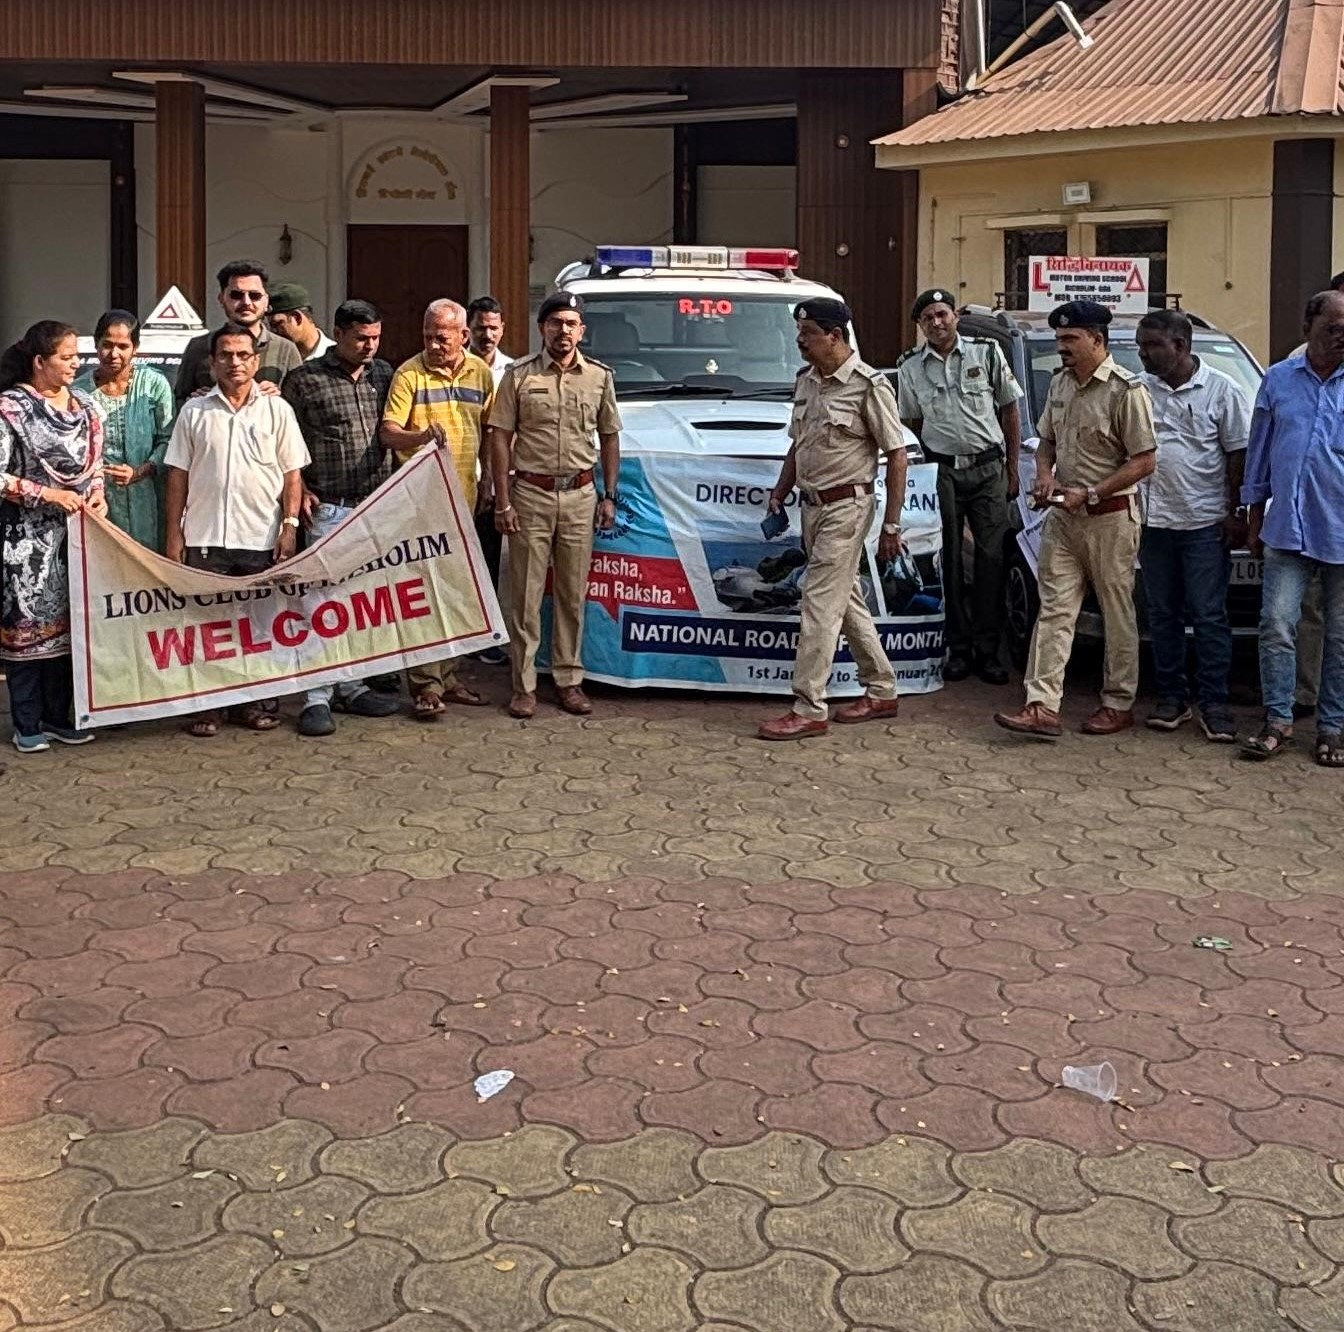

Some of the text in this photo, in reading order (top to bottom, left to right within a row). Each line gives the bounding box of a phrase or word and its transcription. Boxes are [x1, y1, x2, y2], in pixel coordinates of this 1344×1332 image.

[146, 578, 432, 670] WELCOME
[630, 622, 739, 647] NATIONAL
[886, 631, 944, 651] MONTH
[747, 665, 770, 680] 1st
[836, 669, 851, 684] to
